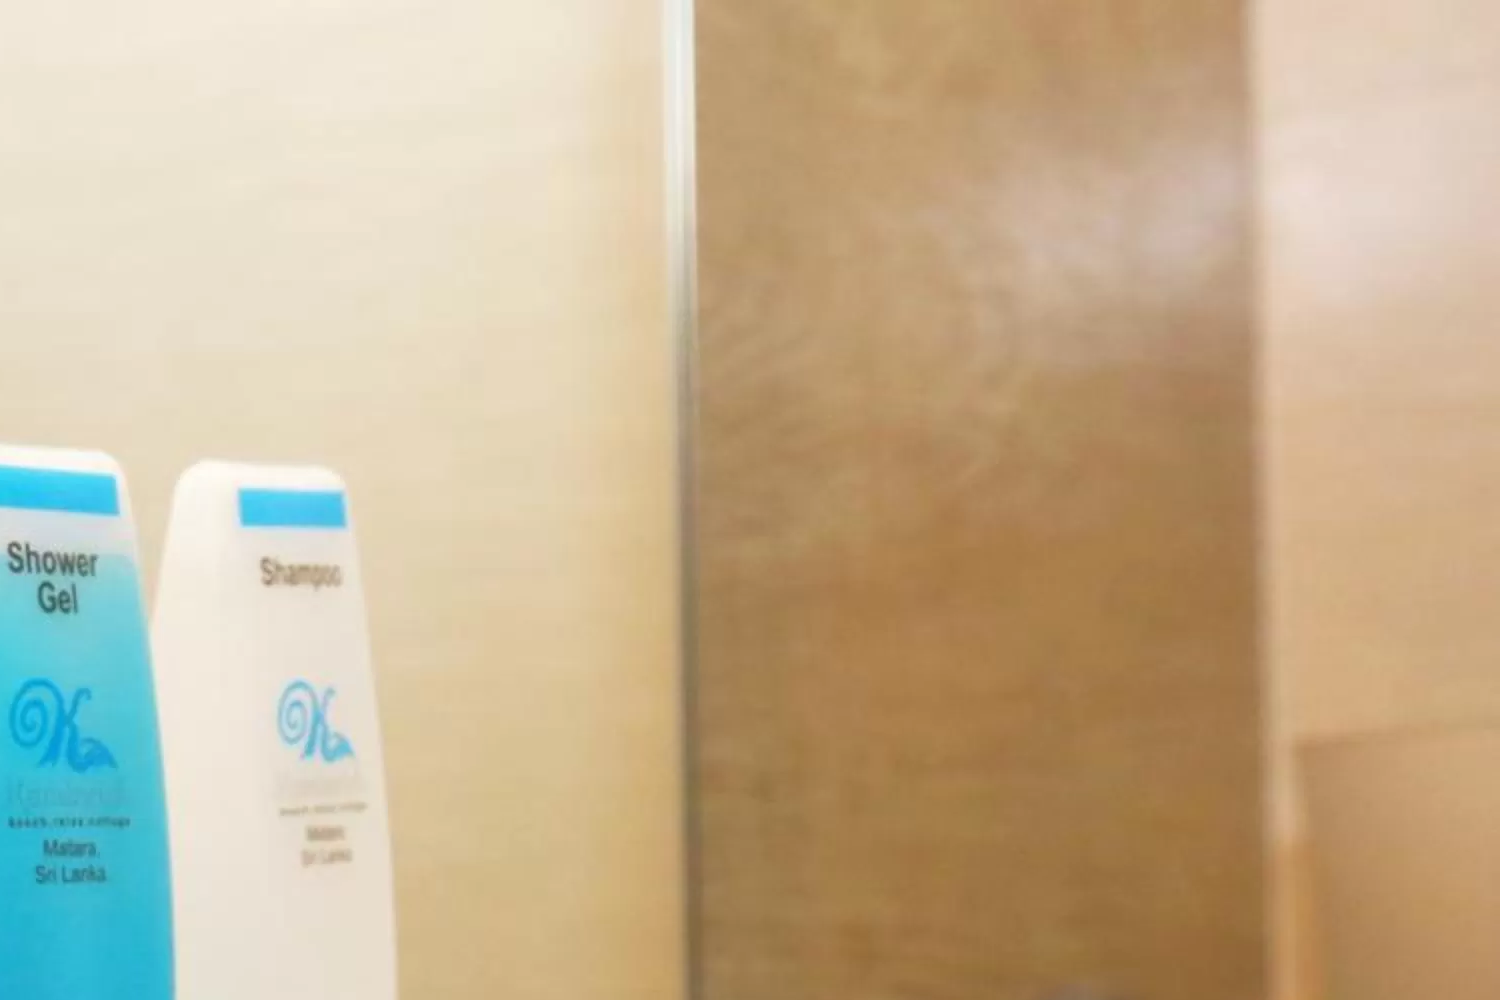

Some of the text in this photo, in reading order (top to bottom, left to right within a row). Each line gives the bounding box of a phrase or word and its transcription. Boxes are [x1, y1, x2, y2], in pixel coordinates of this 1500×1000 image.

[7, 541, 99, 577] Shower
[260, 556, 342, 592] Shampoo
[38, 580, 79, 615] Gel
[35, 865, 57, 885] Sri
